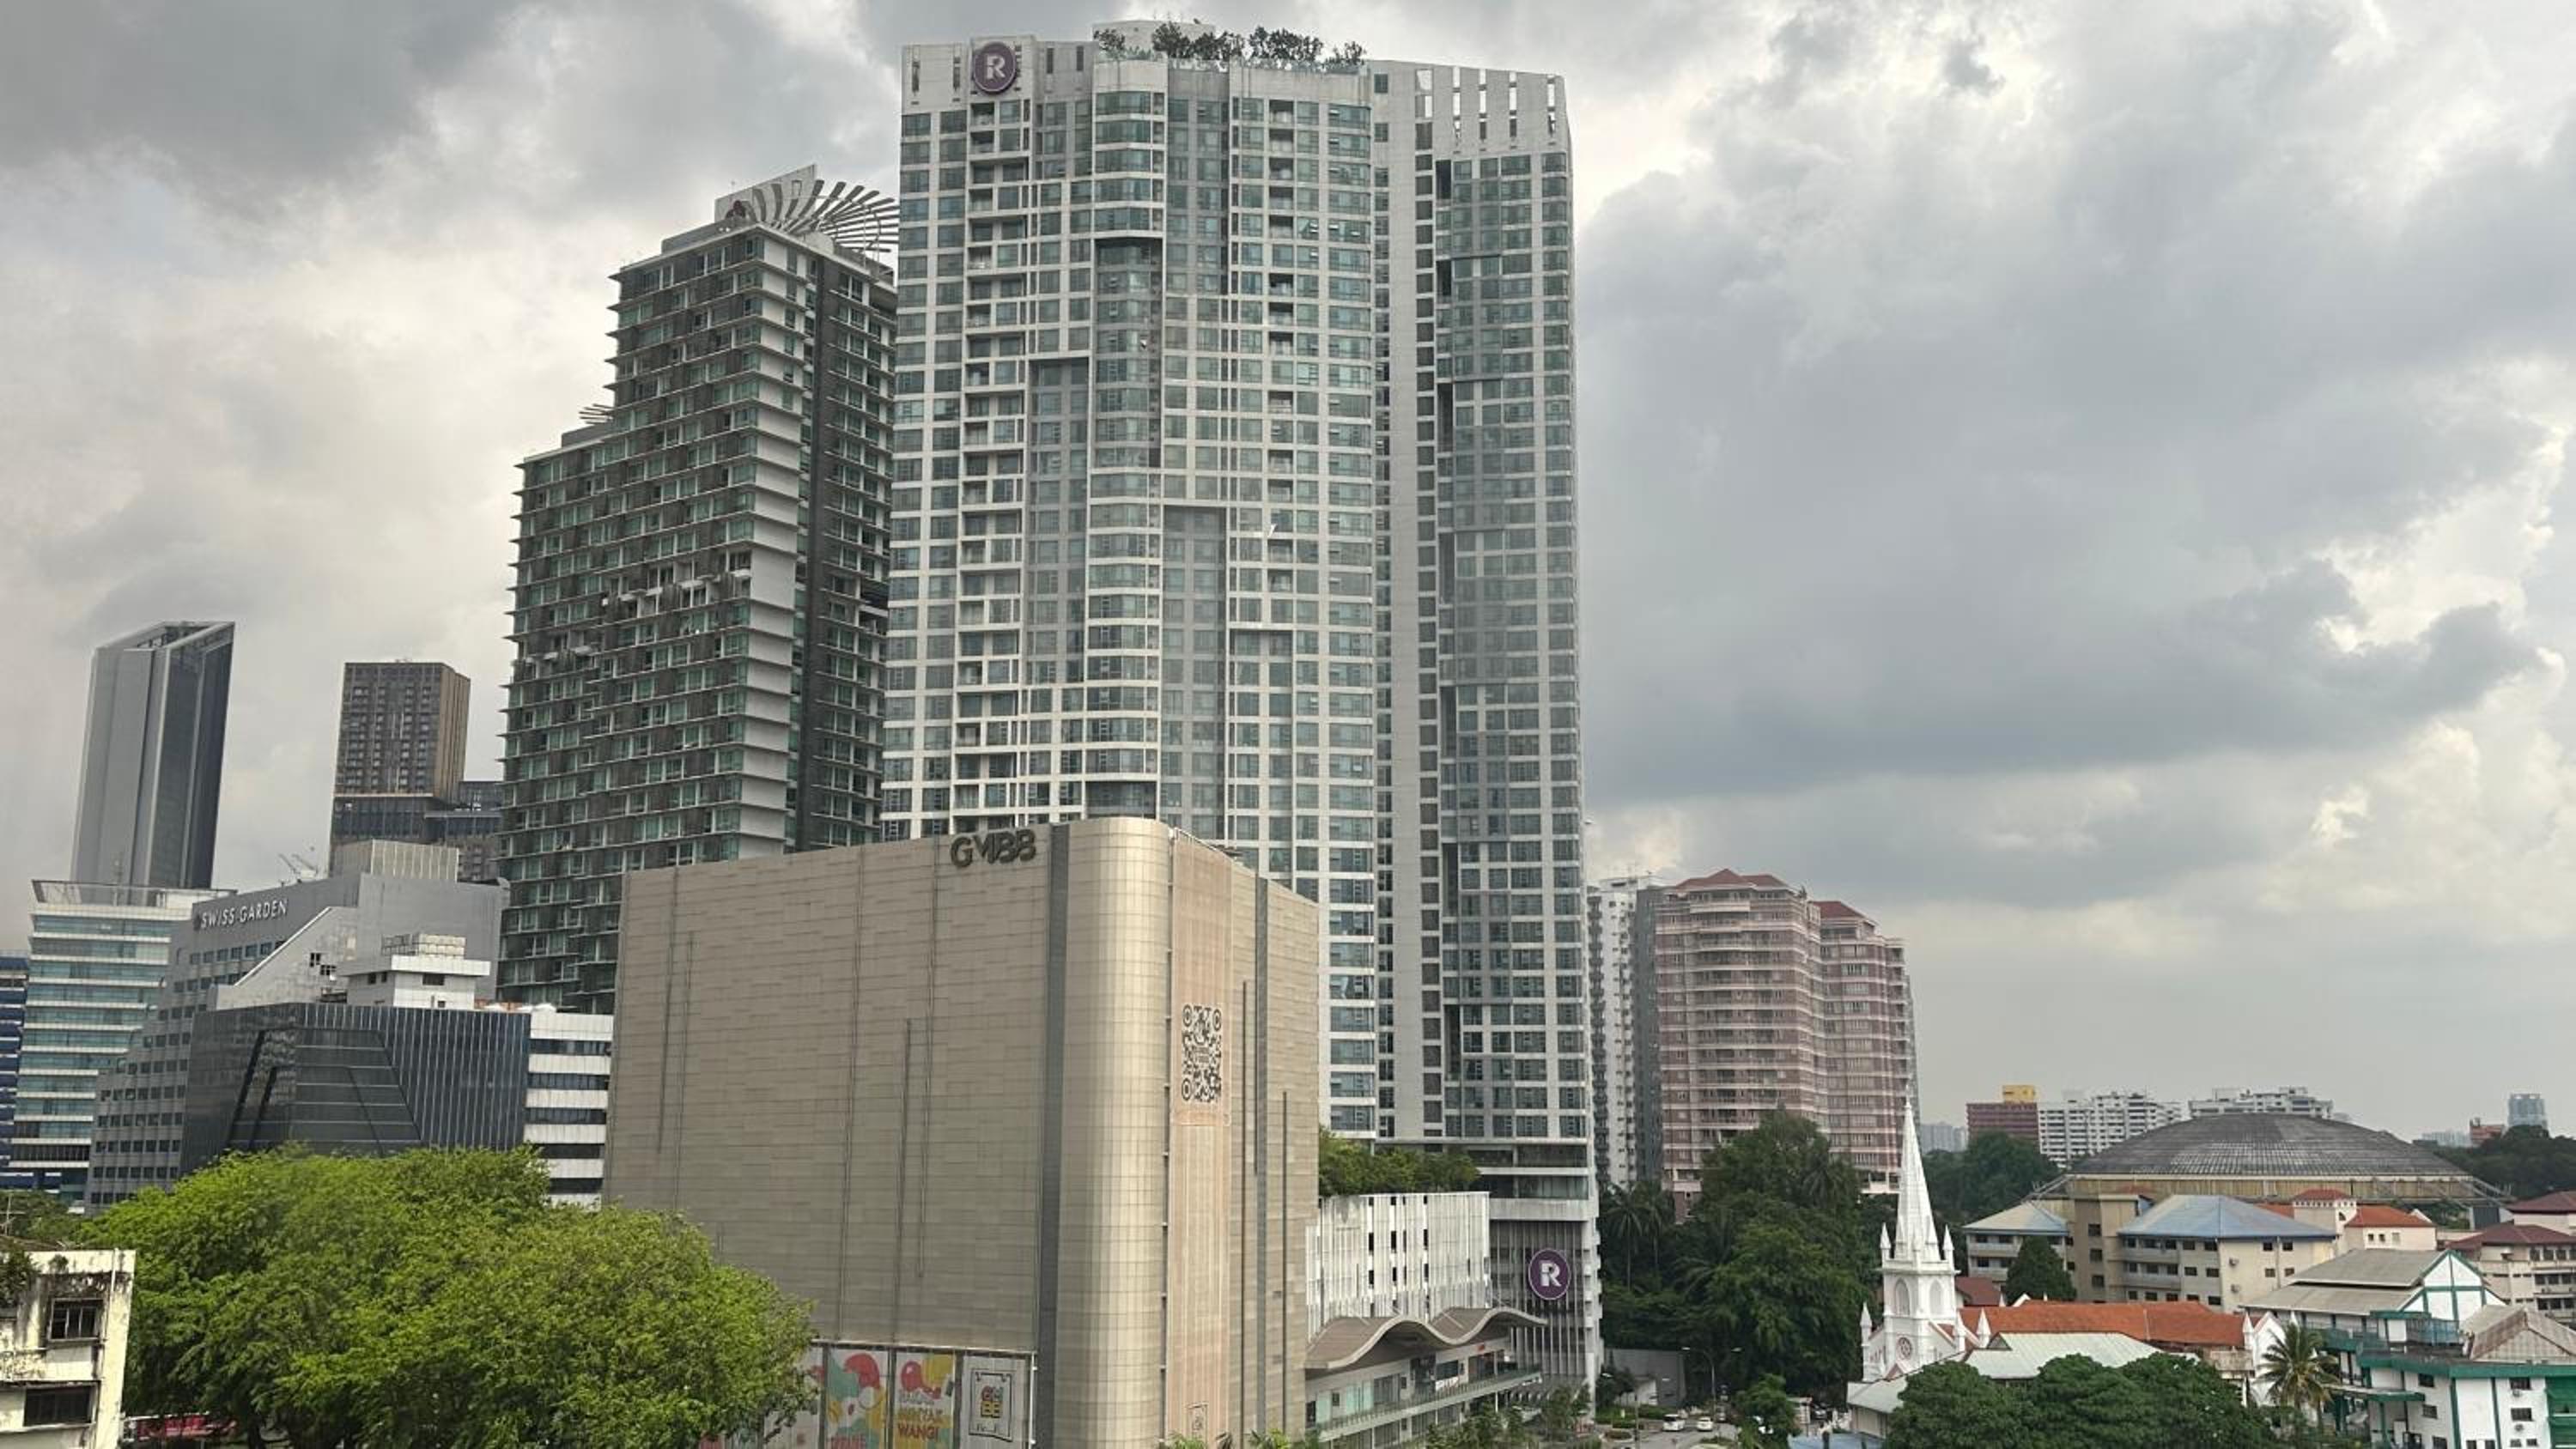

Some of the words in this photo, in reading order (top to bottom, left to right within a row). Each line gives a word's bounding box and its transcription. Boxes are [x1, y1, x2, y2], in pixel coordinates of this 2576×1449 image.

[987, 54, 1005, 80] R
[951, 829, 1036, 868] GMBB
[1540, 1262, 1561, 1287] R
